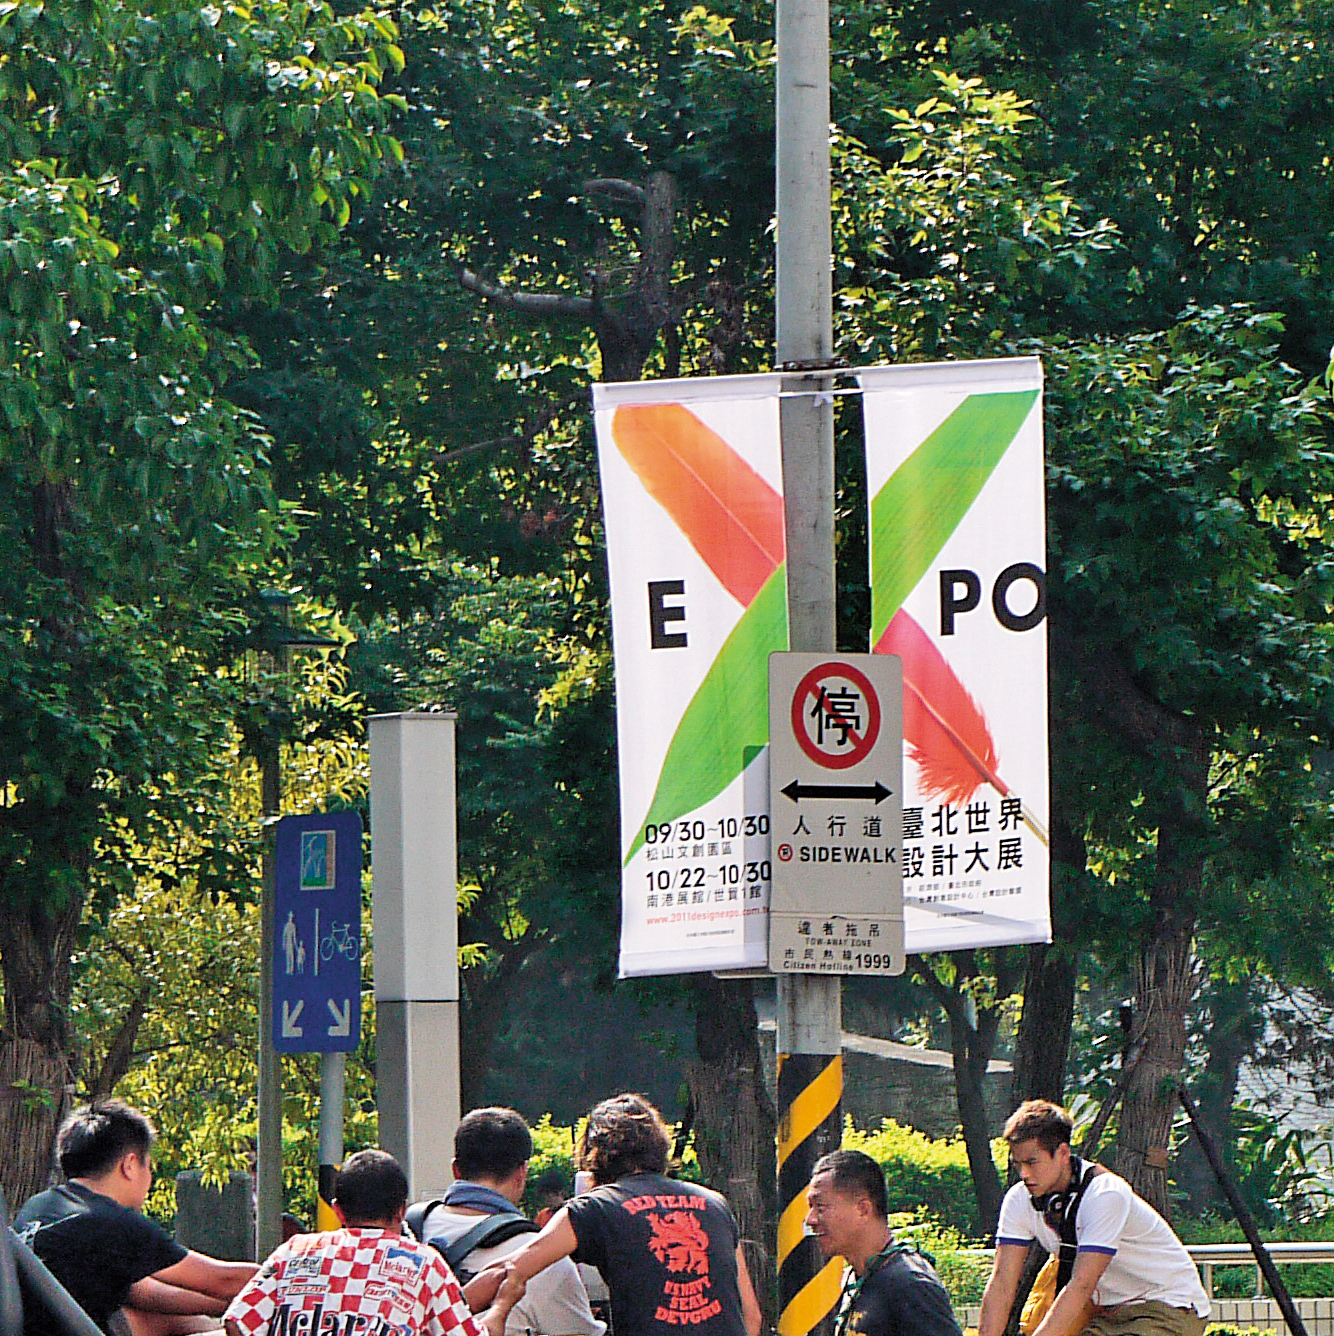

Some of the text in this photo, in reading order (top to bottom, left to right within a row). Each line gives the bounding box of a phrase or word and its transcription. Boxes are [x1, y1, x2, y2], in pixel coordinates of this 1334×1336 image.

[810, 686, 861, 746] 停
[792, 815, 882, 837] 人行道
[902, 798, 1024, 839] 臺北世界
[799, 846, 897, 863] SIDEWALK
[902, 837, 1024, 878] 設計大展
[783, 961, 854, 971] Citizen Hotline
[855, 953, 891, 969] 1999
[621, 1195, 707, 1215] RED TEAM
[654, 1298, 723, 1325] DEVGRU
[670, 1293, 709, 1310] SEAL
